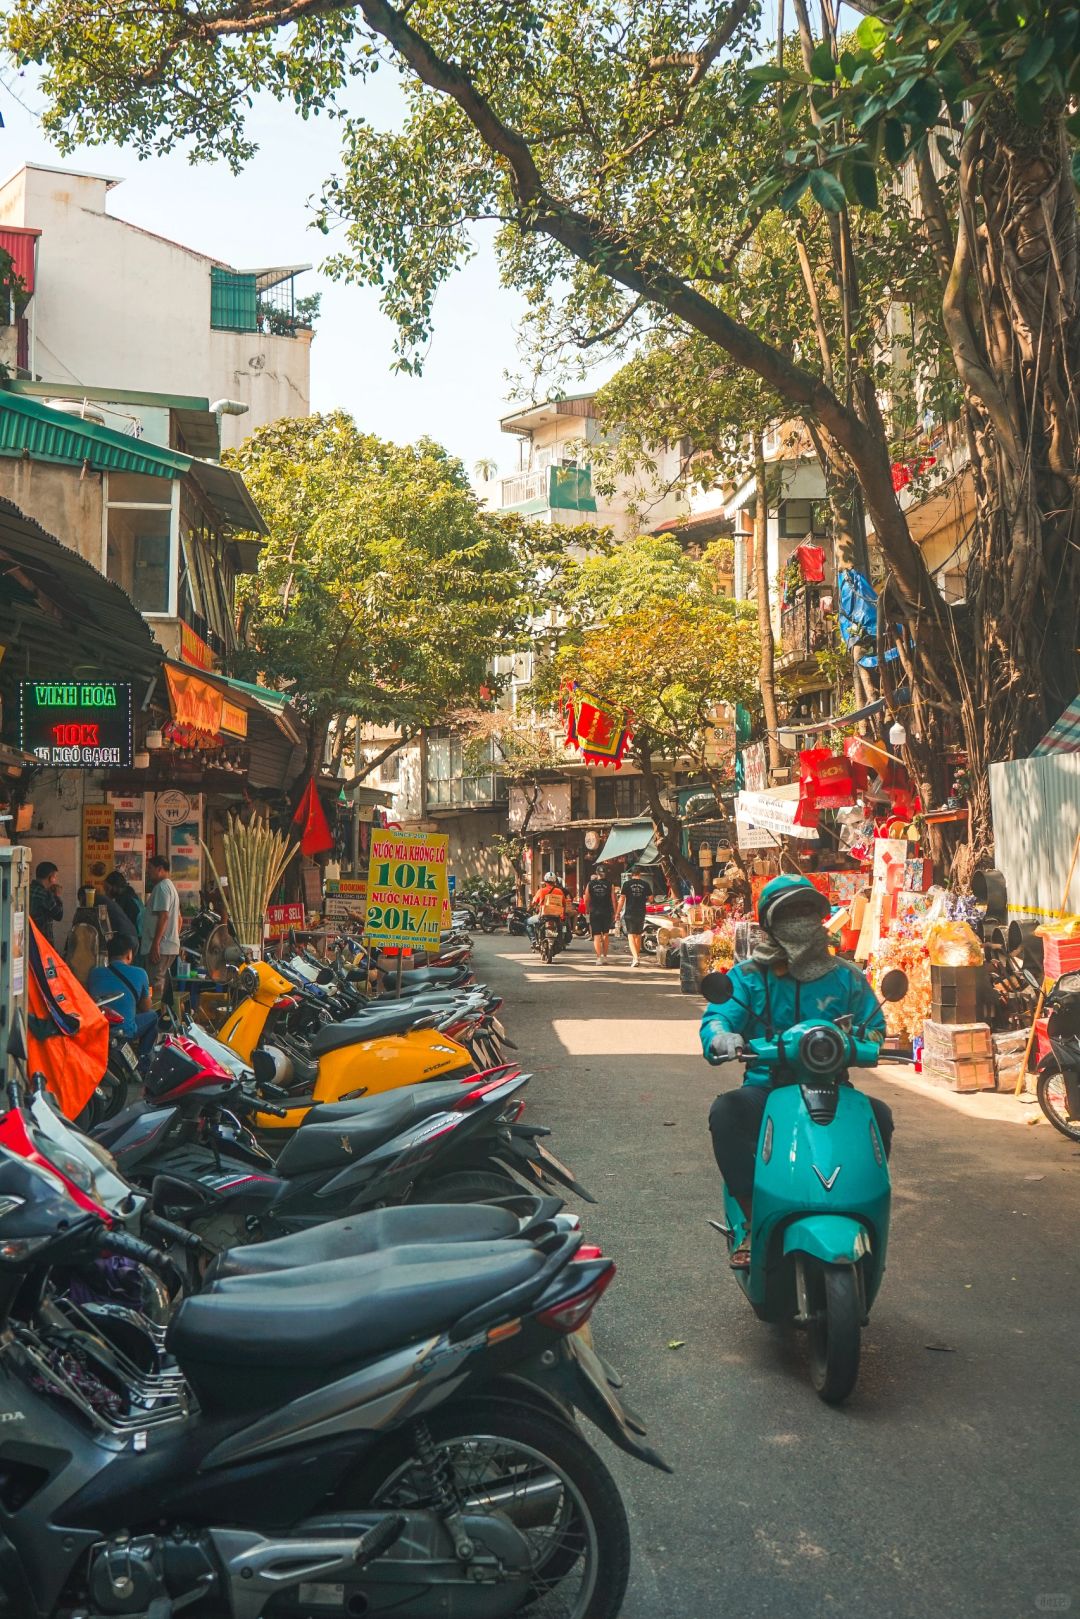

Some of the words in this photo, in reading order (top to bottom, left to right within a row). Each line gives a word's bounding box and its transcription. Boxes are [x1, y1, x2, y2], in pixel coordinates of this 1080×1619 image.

[53, 724, 99, 746] 10K
[82, 747, 120, 767] GẠCH
[375, 863, 438, 890] 10k
[339, 883, 366, 893] BOOKING
[288, 907, 302, 920] SELL
